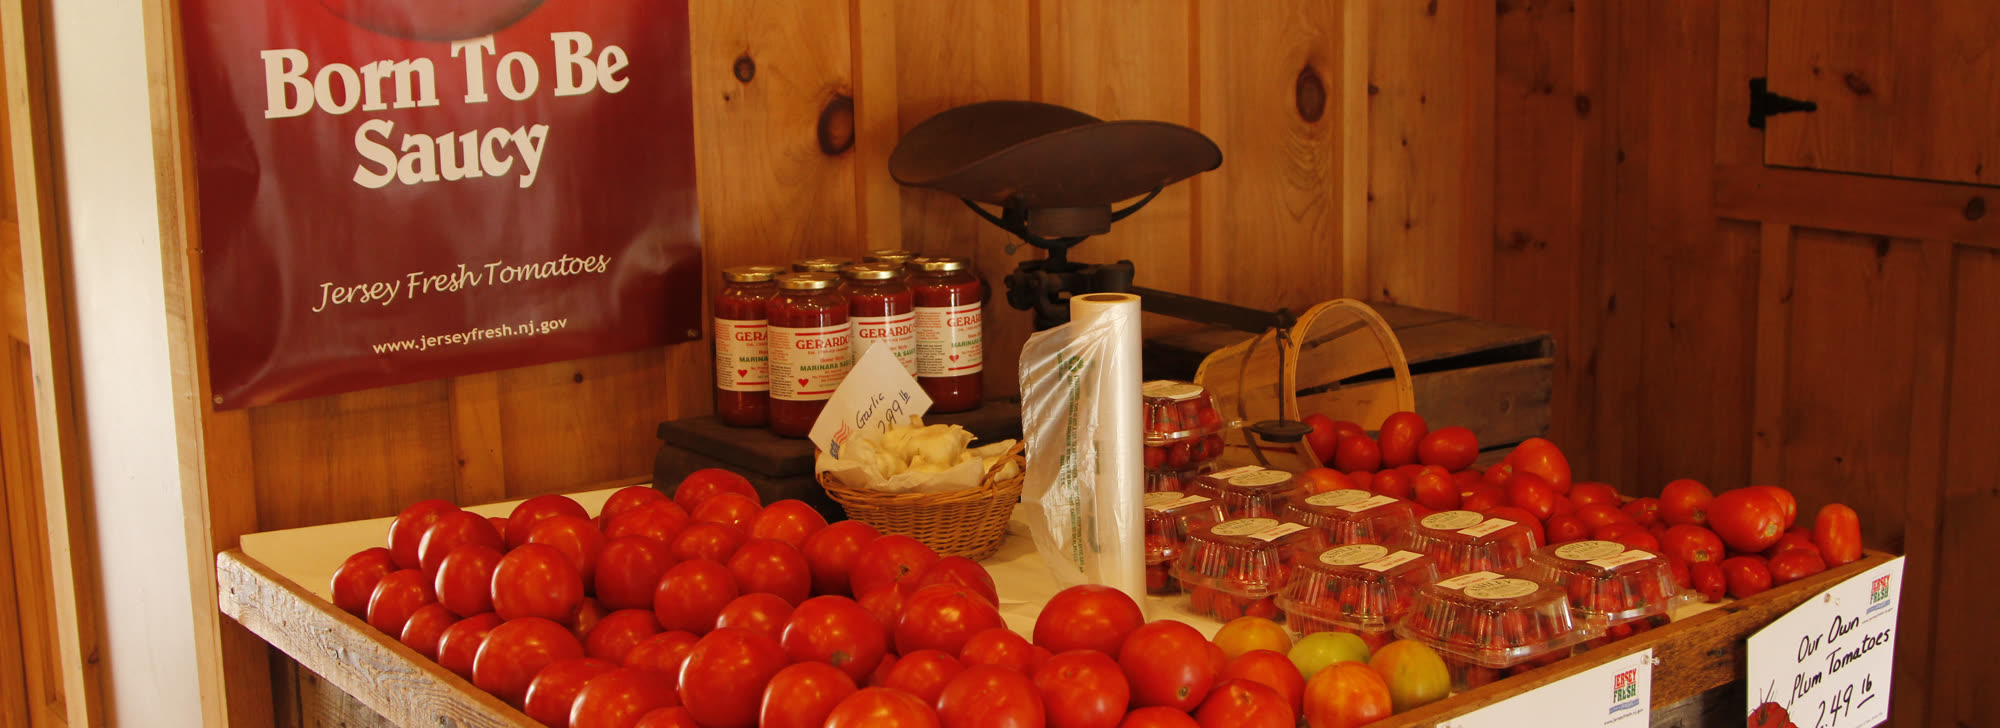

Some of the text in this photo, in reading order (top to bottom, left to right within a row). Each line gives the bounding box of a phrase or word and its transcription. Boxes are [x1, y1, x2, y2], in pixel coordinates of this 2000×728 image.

[260, 31, 630, 119] Born To Be
[353, 118, 550, 189] Saucy
[312, 254, 611, 312] Jersey Fresh Tomatoes
[372, 317, 568, 354] www.jerseyfresh.nj.gov
[856, 392, 885, 429] Garlic
[1797, 634, 1824, 664] Our
[1827, 614, 1860, 644] Own
[1614, 668, 1637, 691] JERSEY
[1791, 628, 1891, 706] Plum Tomatoes
[1613, 683, 1637, 704] FRESH
